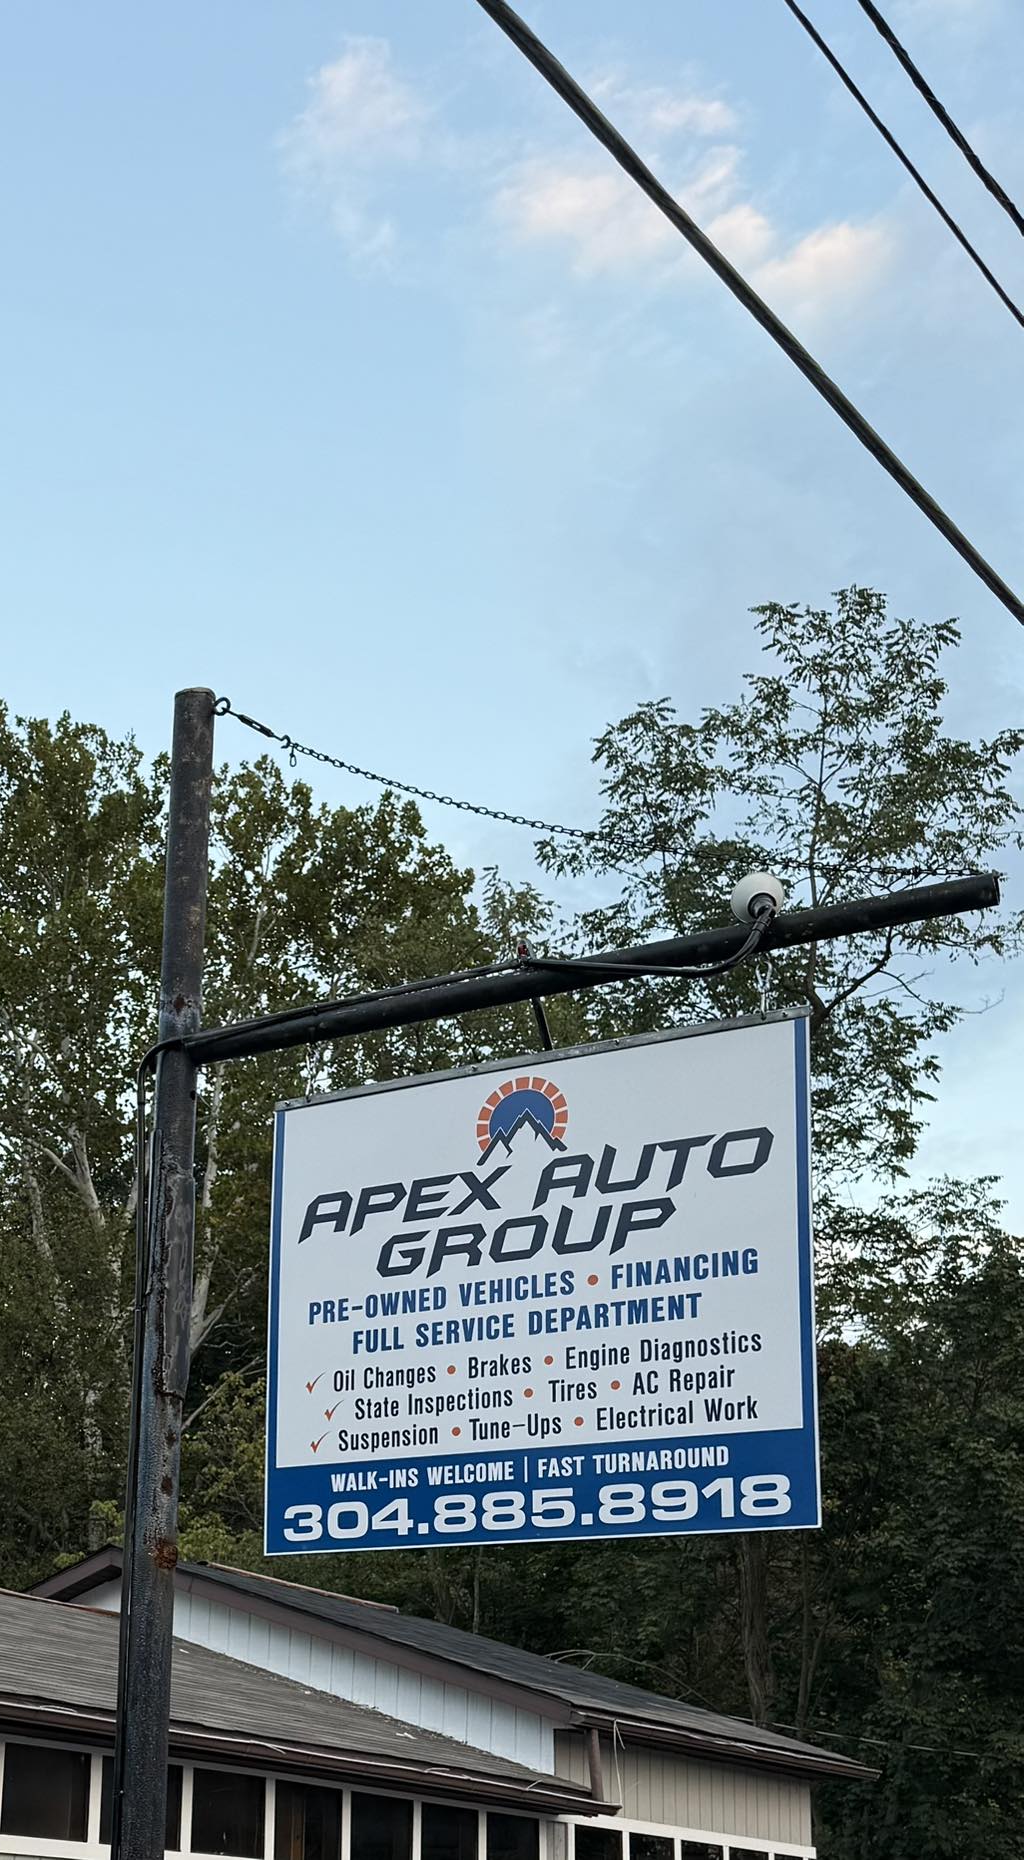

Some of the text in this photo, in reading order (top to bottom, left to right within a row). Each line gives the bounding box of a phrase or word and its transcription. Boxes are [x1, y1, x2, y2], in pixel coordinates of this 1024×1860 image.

[298, 1127, 774, 1244] APEX AUTO
[376, 1197, 677, 1279] GROUP
[309, 1248, 759, 1325] PRE-OWNED VEHICLES FINANCING
[353, 1292, 702, 1354] FULL SERVICE DEPARTMENT
[333, 1331, 762, 1392] Oil Changes Brakes Engine Diagnostics
[355, 1365, 735, 1420] State Inspections Tires AC Repair
[338, 1396, 759, 1452] Suspension Tune-Ups Electrical Work
[331, 1446, 729, 1492] WALK-INS WELCOME FAST TURNAROUND
[283, 1474, 792, 1542] 304.885.8918
